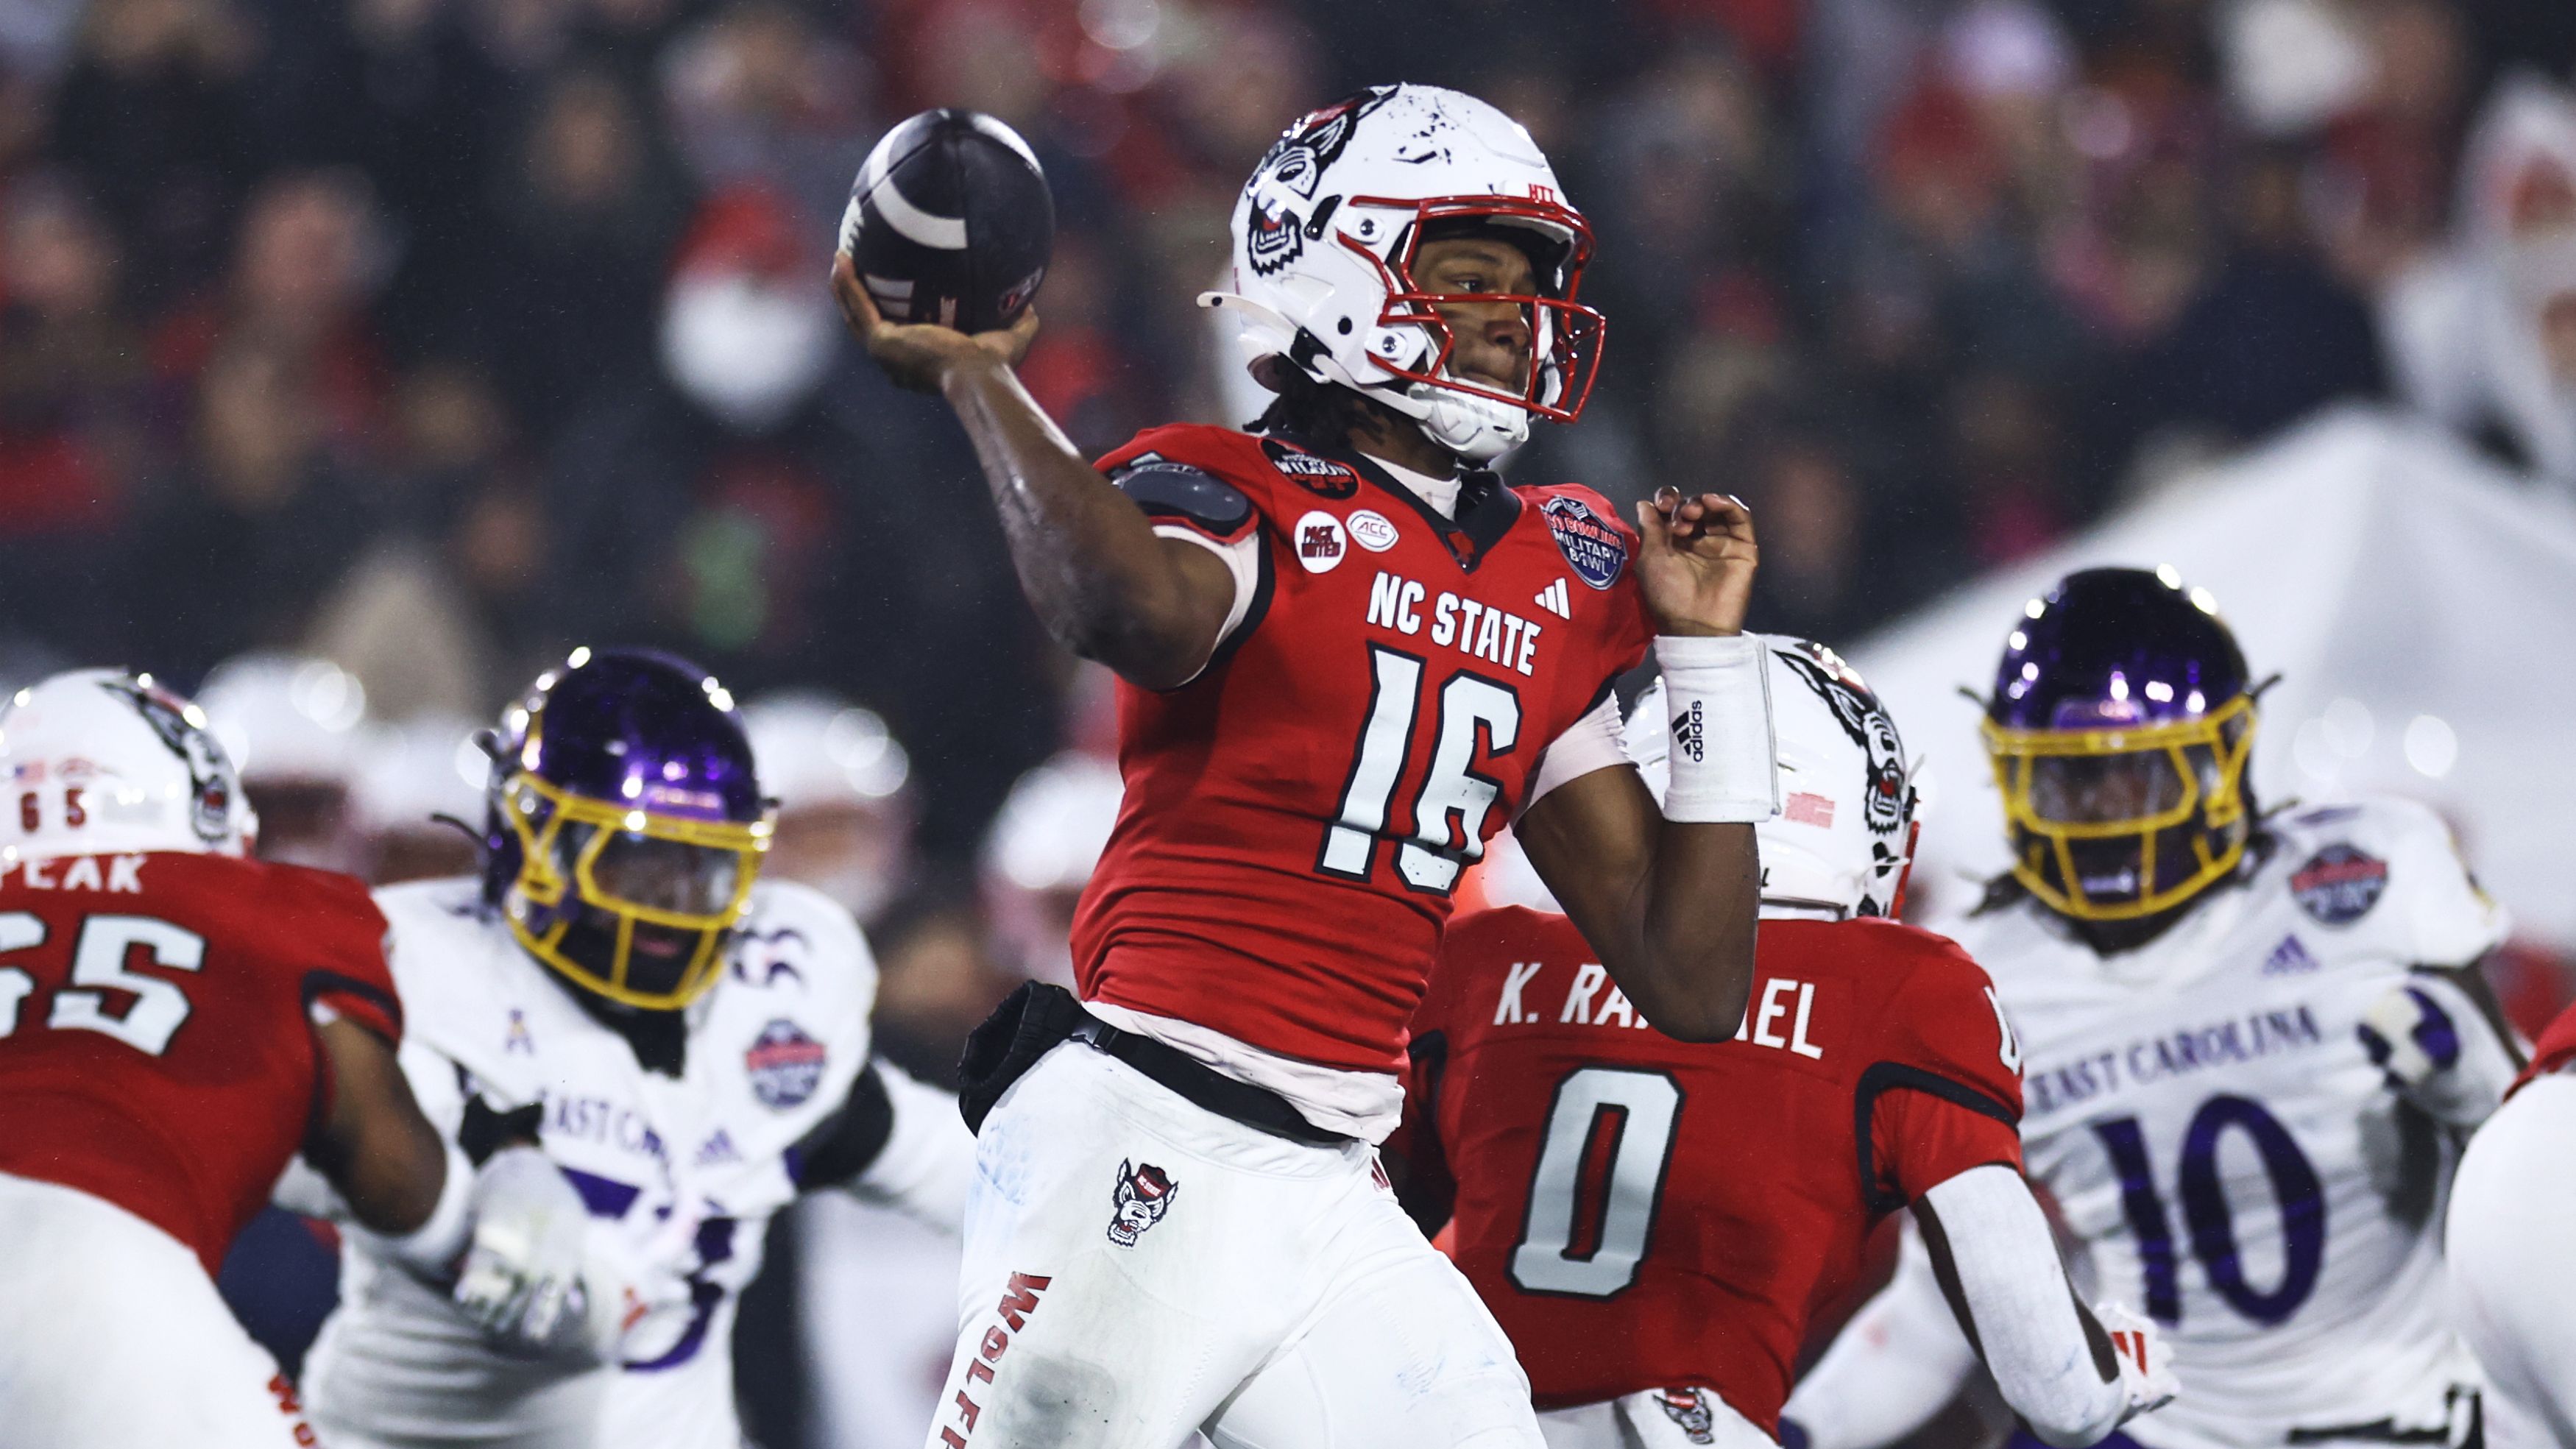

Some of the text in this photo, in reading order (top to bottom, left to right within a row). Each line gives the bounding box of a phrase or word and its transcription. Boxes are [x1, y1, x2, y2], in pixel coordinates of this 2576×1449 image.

[1273, 459, 1351, 476] WILSON
[1357, 521, 1388, 536] ACC
[1553, 529, 1618, 565] MILITARY
[1568, 547, 1609, 576] BOWL
[1366, 571, 1543, 676] NC STATE
[1692, 700, 1704, 762] adidas
[1318, 642, 1522, 896] 16
[1493, 963, 1541, 1026] K.
[1506, 1066, 1685, 1303] 0
[2092, 1092, 2325, 1326] 10
